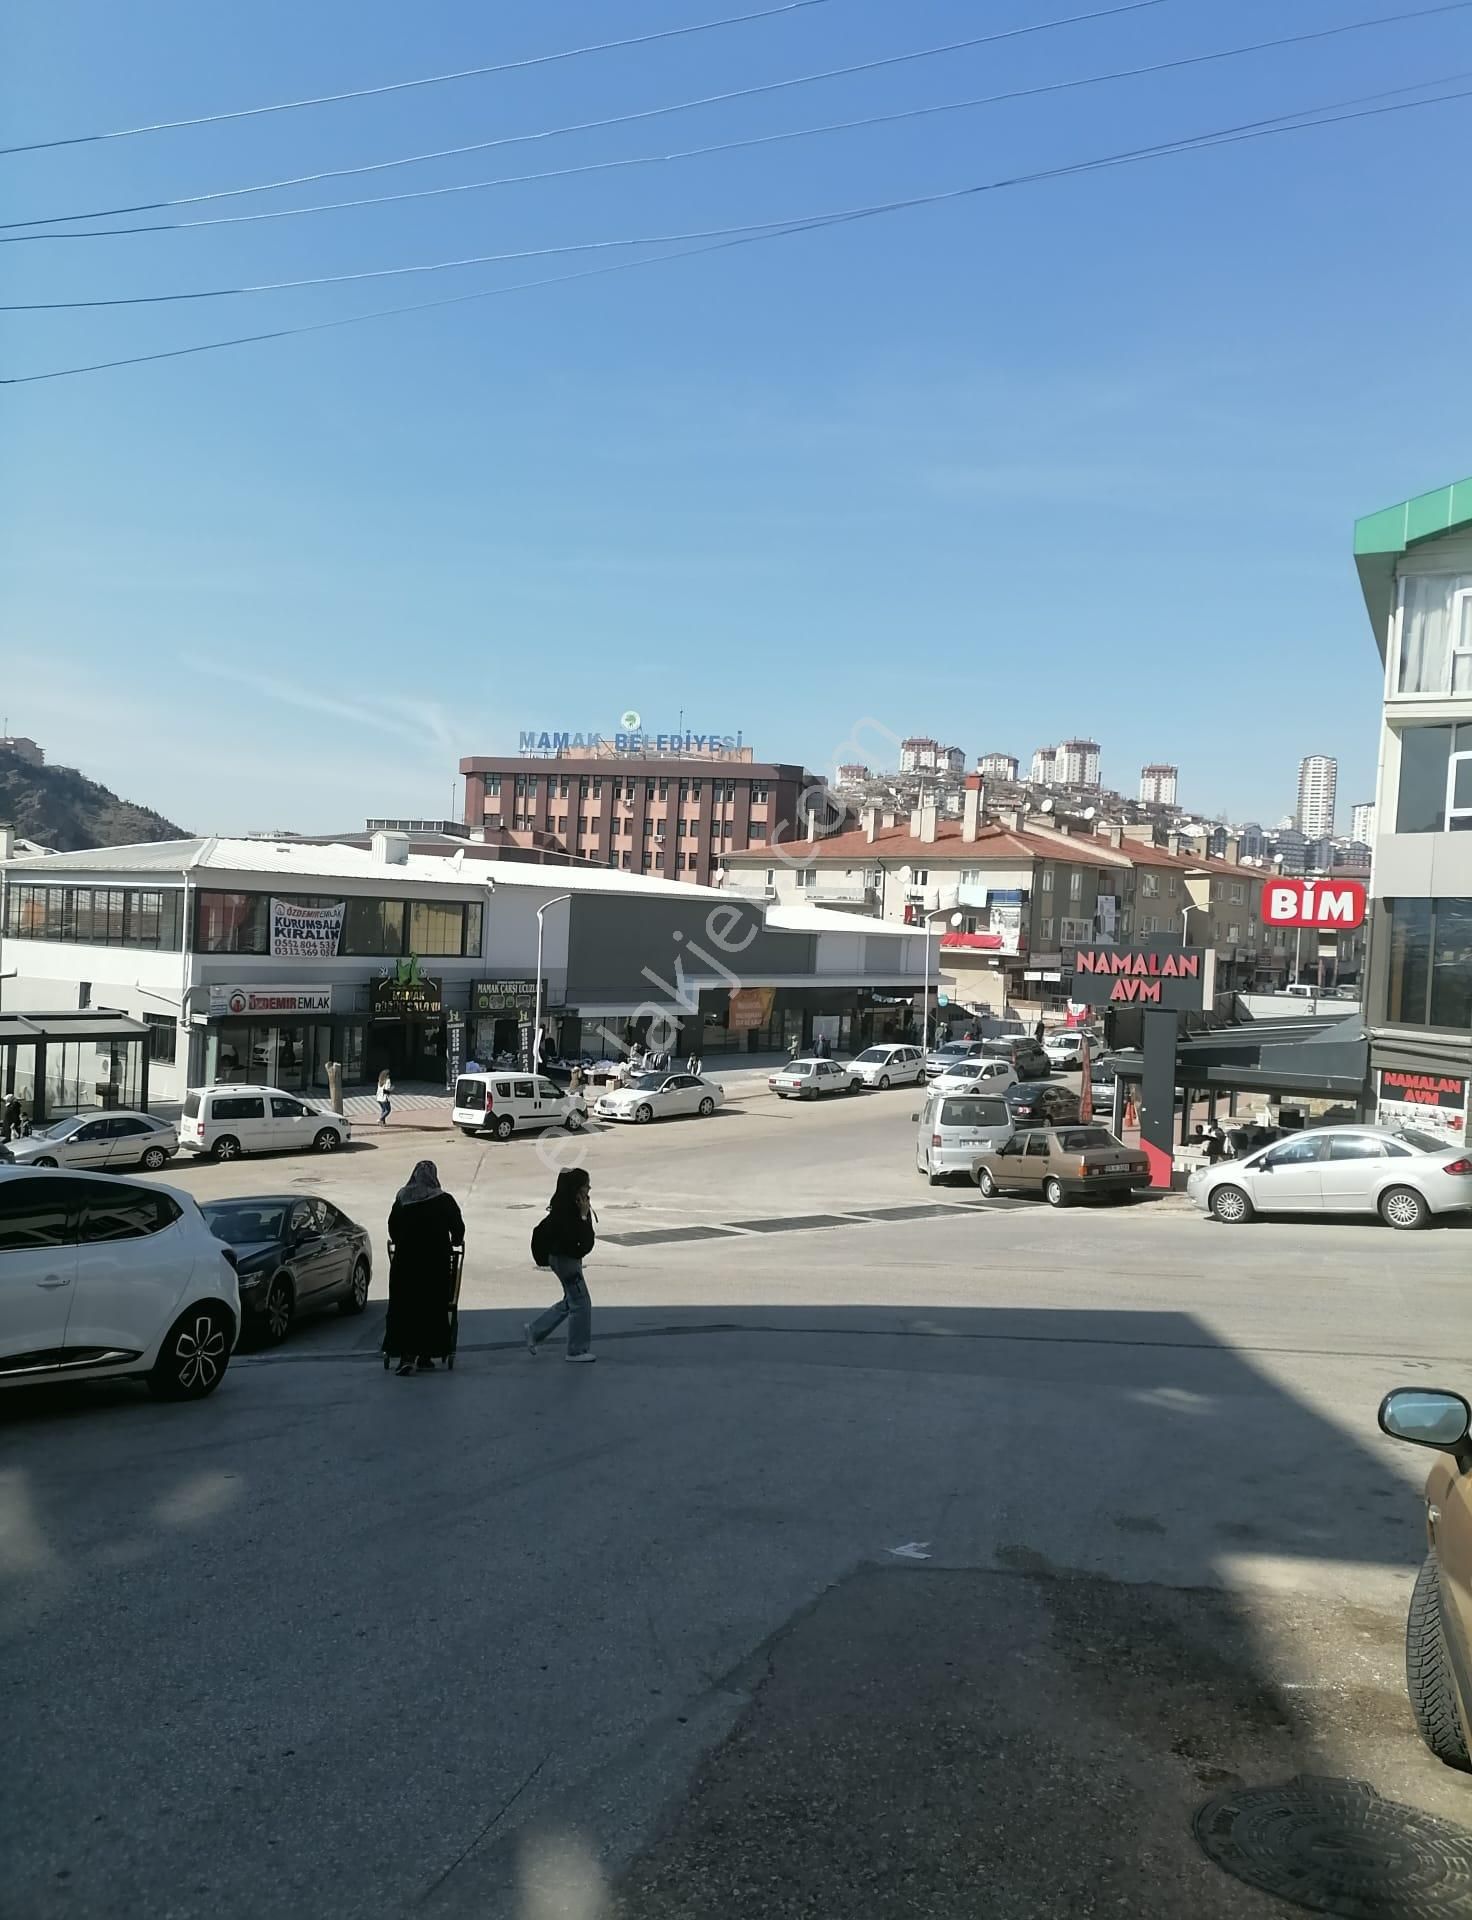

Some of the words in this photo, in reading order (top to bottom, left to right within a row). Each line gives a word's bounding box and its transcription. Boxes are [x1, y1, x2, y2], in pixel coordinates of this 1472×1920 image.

[520, 732, 601, 749] MAMAK
[615, 730, 743, 752] BELEDİYESİ
[1271, 881, 1354, 922] BİM
[275, 948, 300, 956] 0312
[1077, 951, 1198, 977] NAMALAN
[477, 983, 500, 994] MAMAK
[1110, 979, 1162, 1002] AVM
[297, 997, 330, 1009] EMLAK
[1384, 1071, 1461, 1094] NAMALAN
[1403, 1088, 1440, 1106] AVM
